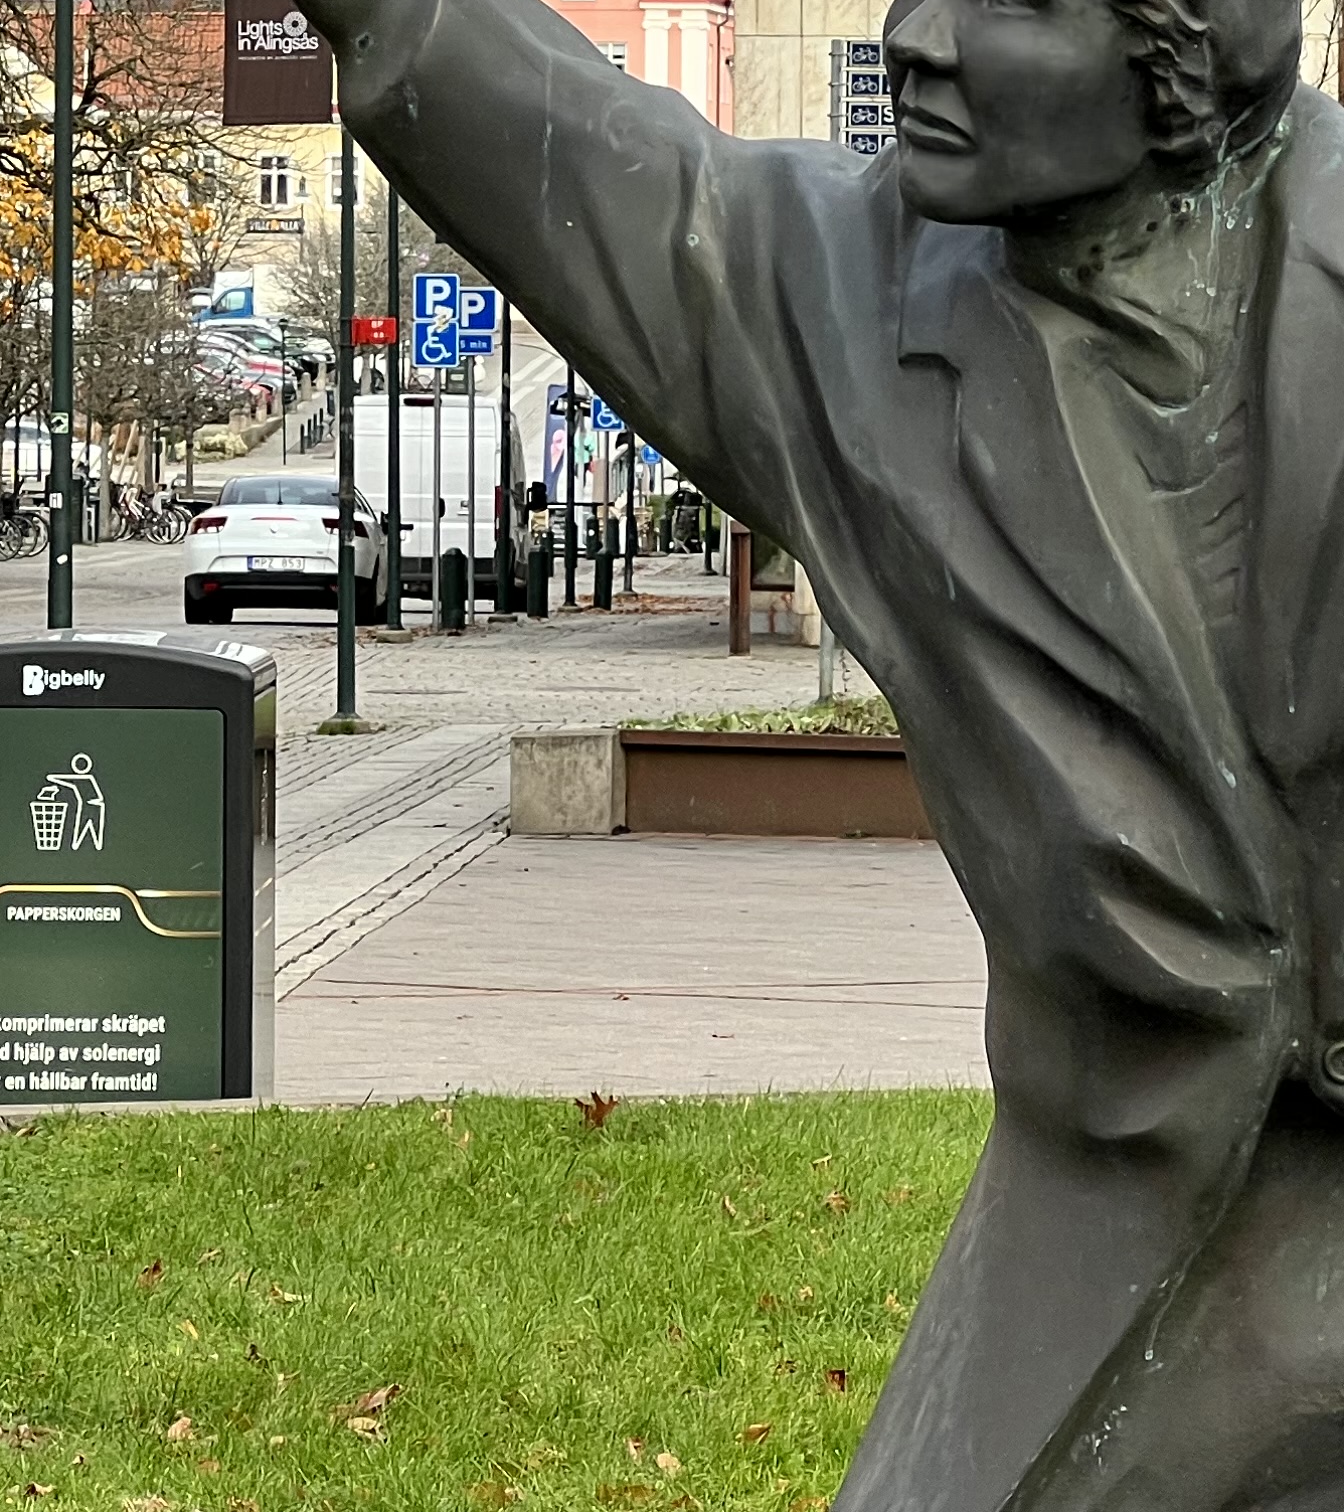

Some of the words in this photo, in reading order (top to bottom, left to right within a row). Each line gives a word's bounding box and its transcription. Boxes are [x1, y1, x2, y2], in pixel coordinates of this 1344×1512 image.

[238, 20, 283, 39] Lights
[238, 36, 251, 51] in
[254, 32, 319, 54] Alingsås
[425, 279, 451, 315] P
[461, 293, 485, 327] P
[22, 665, 106, 696] Bigbelly
[7, 905, 121, 922] PAPPERSKORGEN
[102, 1014, 166, 1037] skräpet
[13, 1042, 55, 1065] hjälp
[59, 1046, 79, 1061] av
[82, 1043, 161, 1066] solenergi
[4, 1075, 26, 1090] en
[29, 1071, 88, 1091] hållbar
[91, 1072, 158, 1092] framtid!
